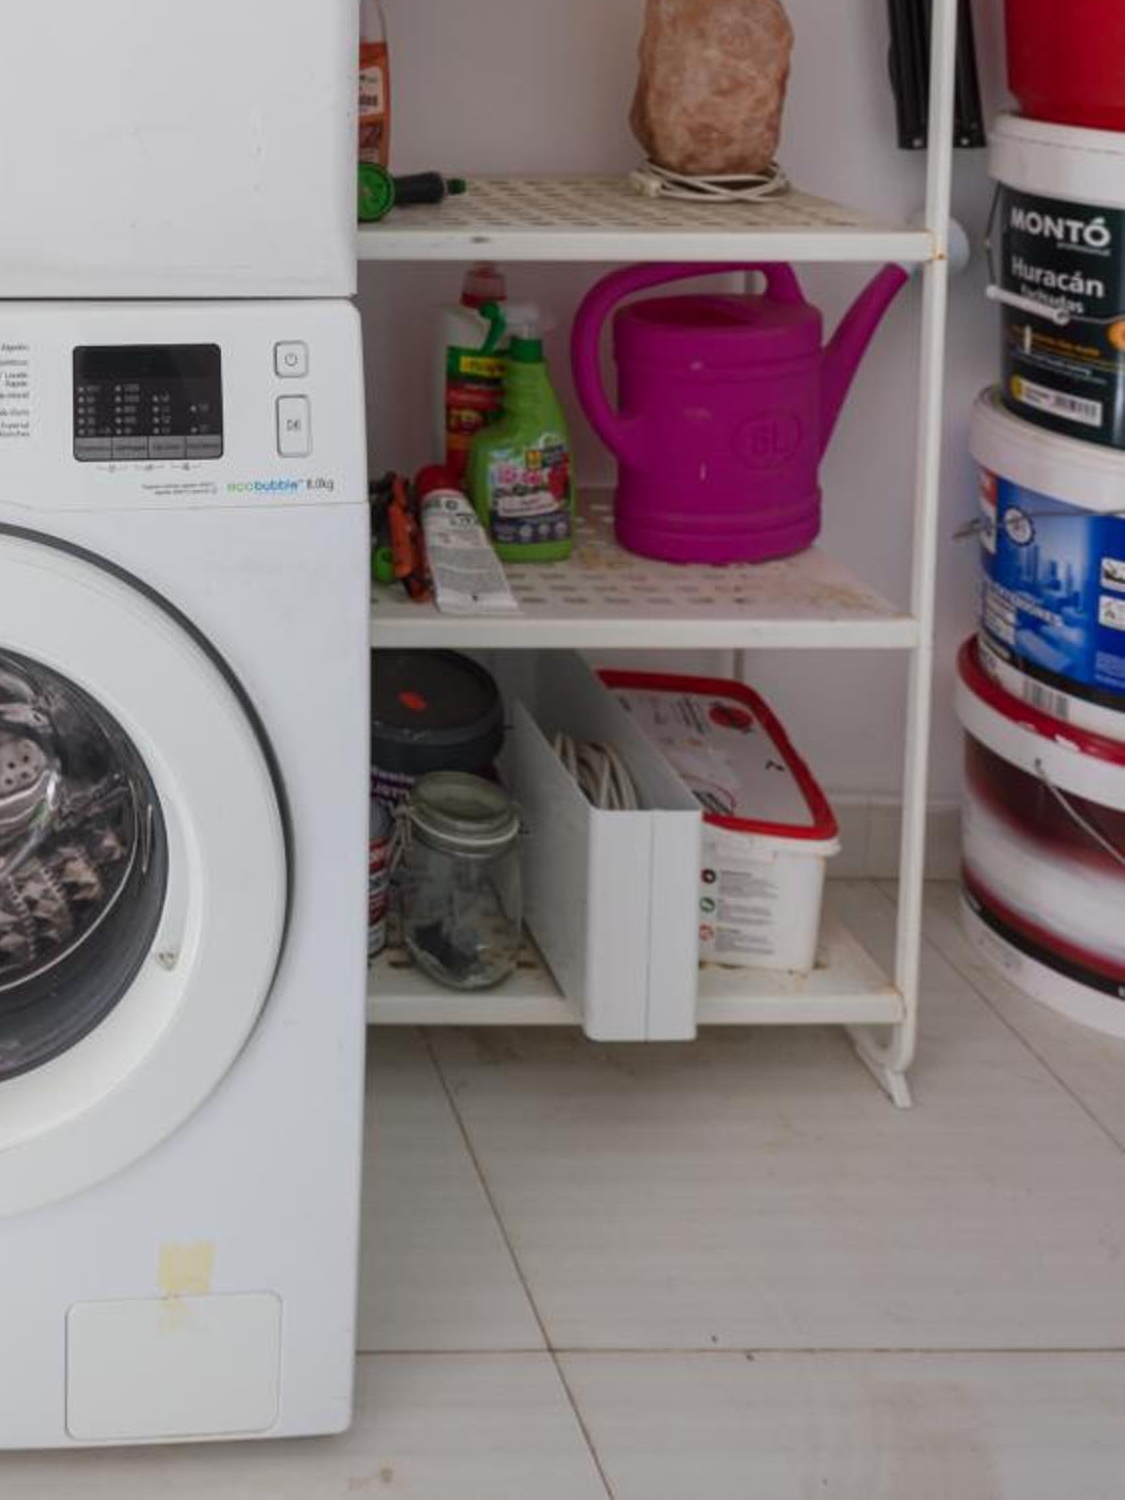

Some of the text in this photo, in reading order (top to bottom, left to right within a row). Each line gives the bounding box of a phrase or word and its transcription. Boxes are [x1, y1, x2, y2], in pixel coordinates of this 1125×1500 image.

[1010, 206, 1112, 248] MONTÓ
[1011, 255, 1105, 298] Huracán
[227, 477, 299, 492] ecobubble
